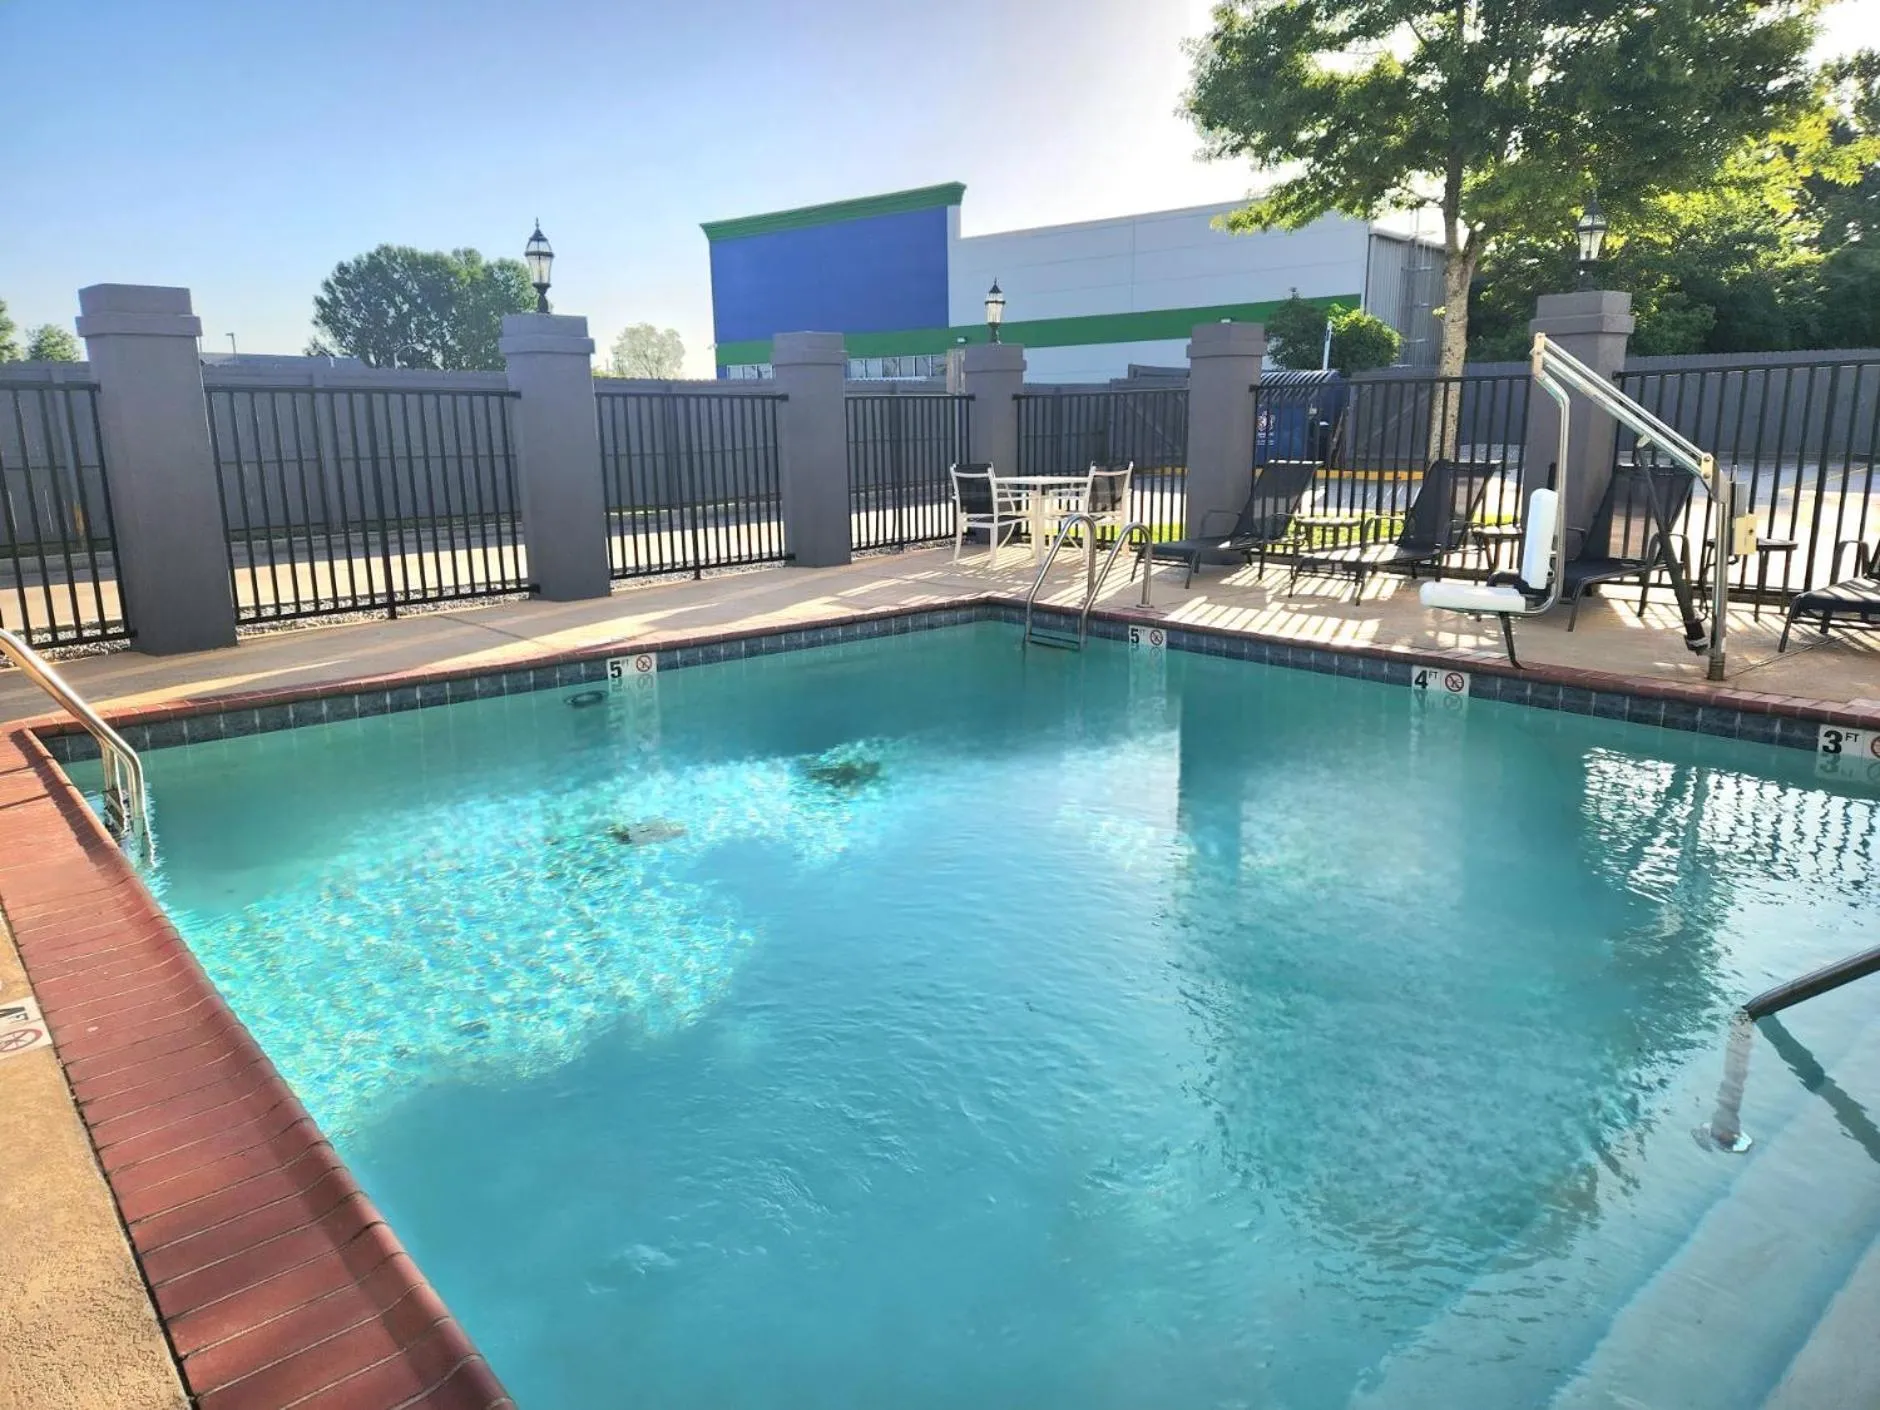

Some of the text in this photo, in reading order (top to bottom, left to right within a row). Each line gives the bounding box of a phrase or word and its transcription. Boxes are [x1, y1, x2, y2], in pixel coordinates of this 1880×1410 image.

[1130, 627, 1140, 644] 5
[609, 660, 623, 678] 5
[1414, 669, 1438, 689] 4 FT
[1822, 730, 1859, 754] 3 FT
